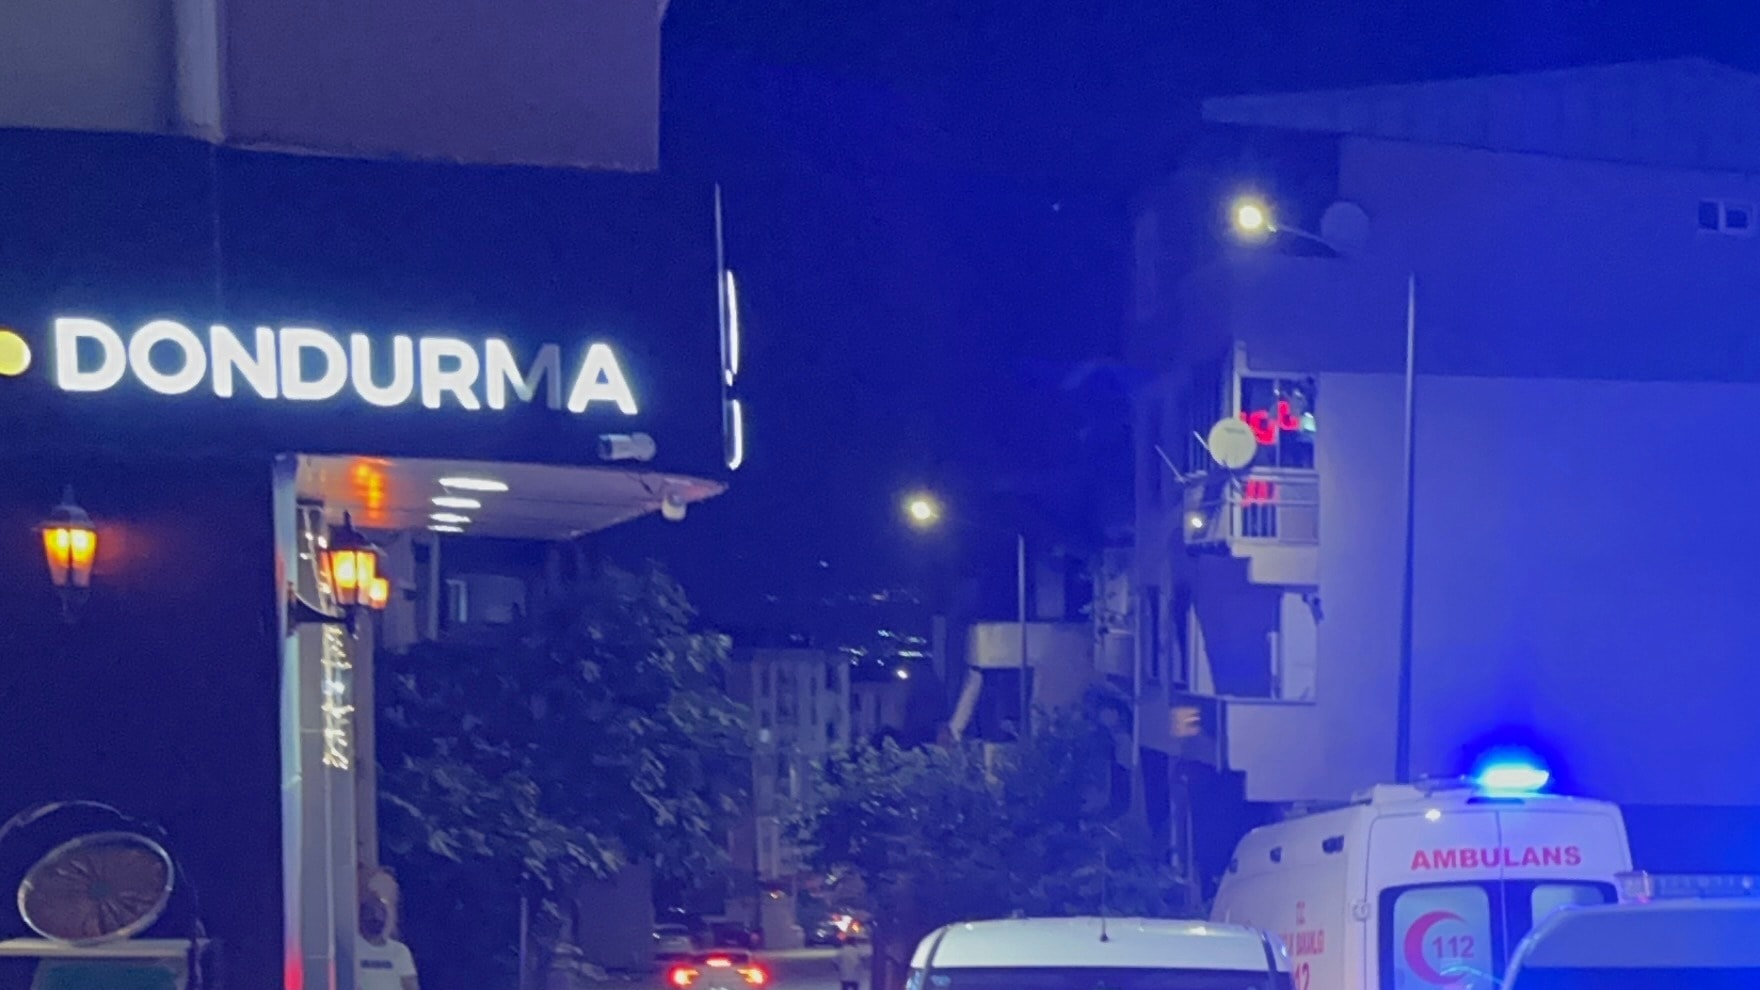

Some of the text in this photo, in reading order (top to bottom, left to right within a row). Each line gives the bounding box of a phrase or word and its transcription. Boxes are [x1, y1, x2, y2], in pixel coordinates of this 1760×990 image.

[54, 317, 639, 415] DONDURMA
[1410, 846, 1582, 871] AMBULANS
[1431, 935, 1475, 959] 112
